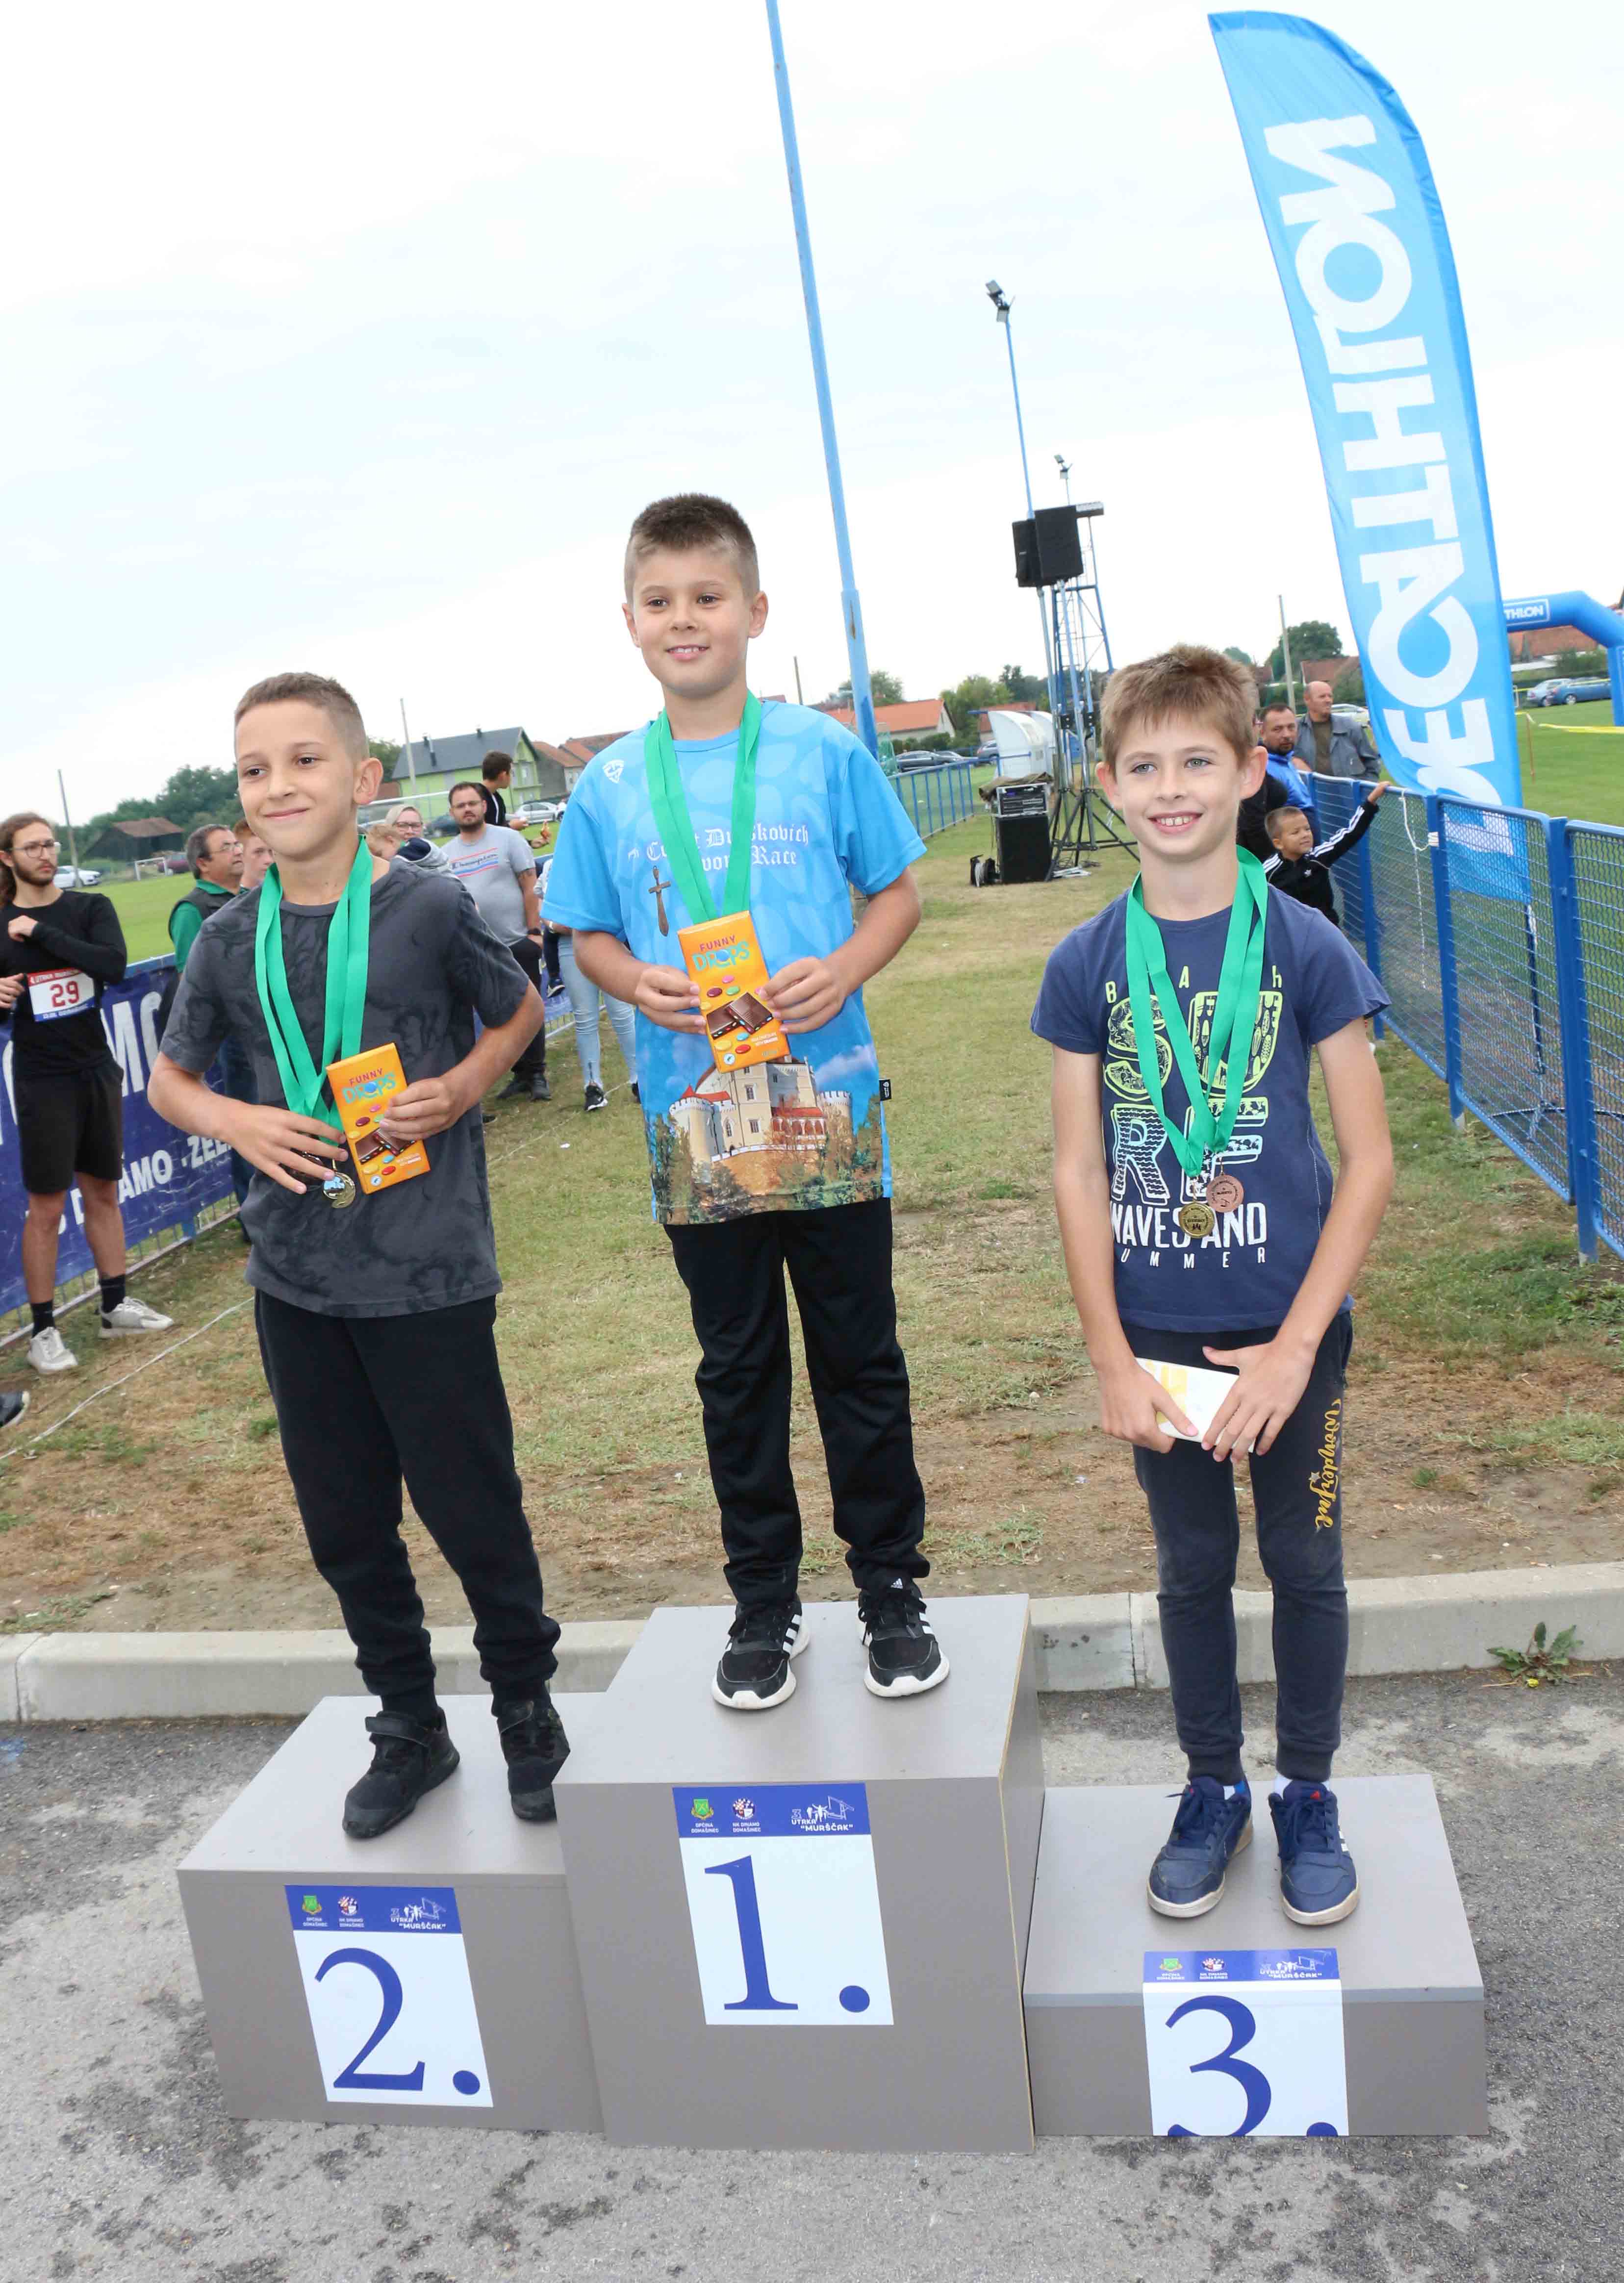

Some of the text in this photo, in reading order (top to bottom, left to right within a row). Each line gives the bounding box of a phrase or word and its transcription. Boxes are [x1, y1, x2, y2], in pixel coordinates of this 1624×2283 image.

[1504, 605, 1544, 620] THLON
[752, 845, 797, 865] Race
[692, 940, 750, 972] DROPS
[700, 935, 736, 951] FUNNY
[50, 981, 79, 1007] 29
[342, 1072, 397, 1104] DROPS
[349, 1068, 383, 1087] FUNNY
[1110, 1200, 1191, 1248] WAVES
[1200, 1202, 1267, 1249] AND
[1120, 1247, 1266, 1269] UMMER
[705, 1855, 870, 2013] 1.
[314, 1947, 481, 2095] 2.
[1165, 1995, 1338, 2136] 3.
